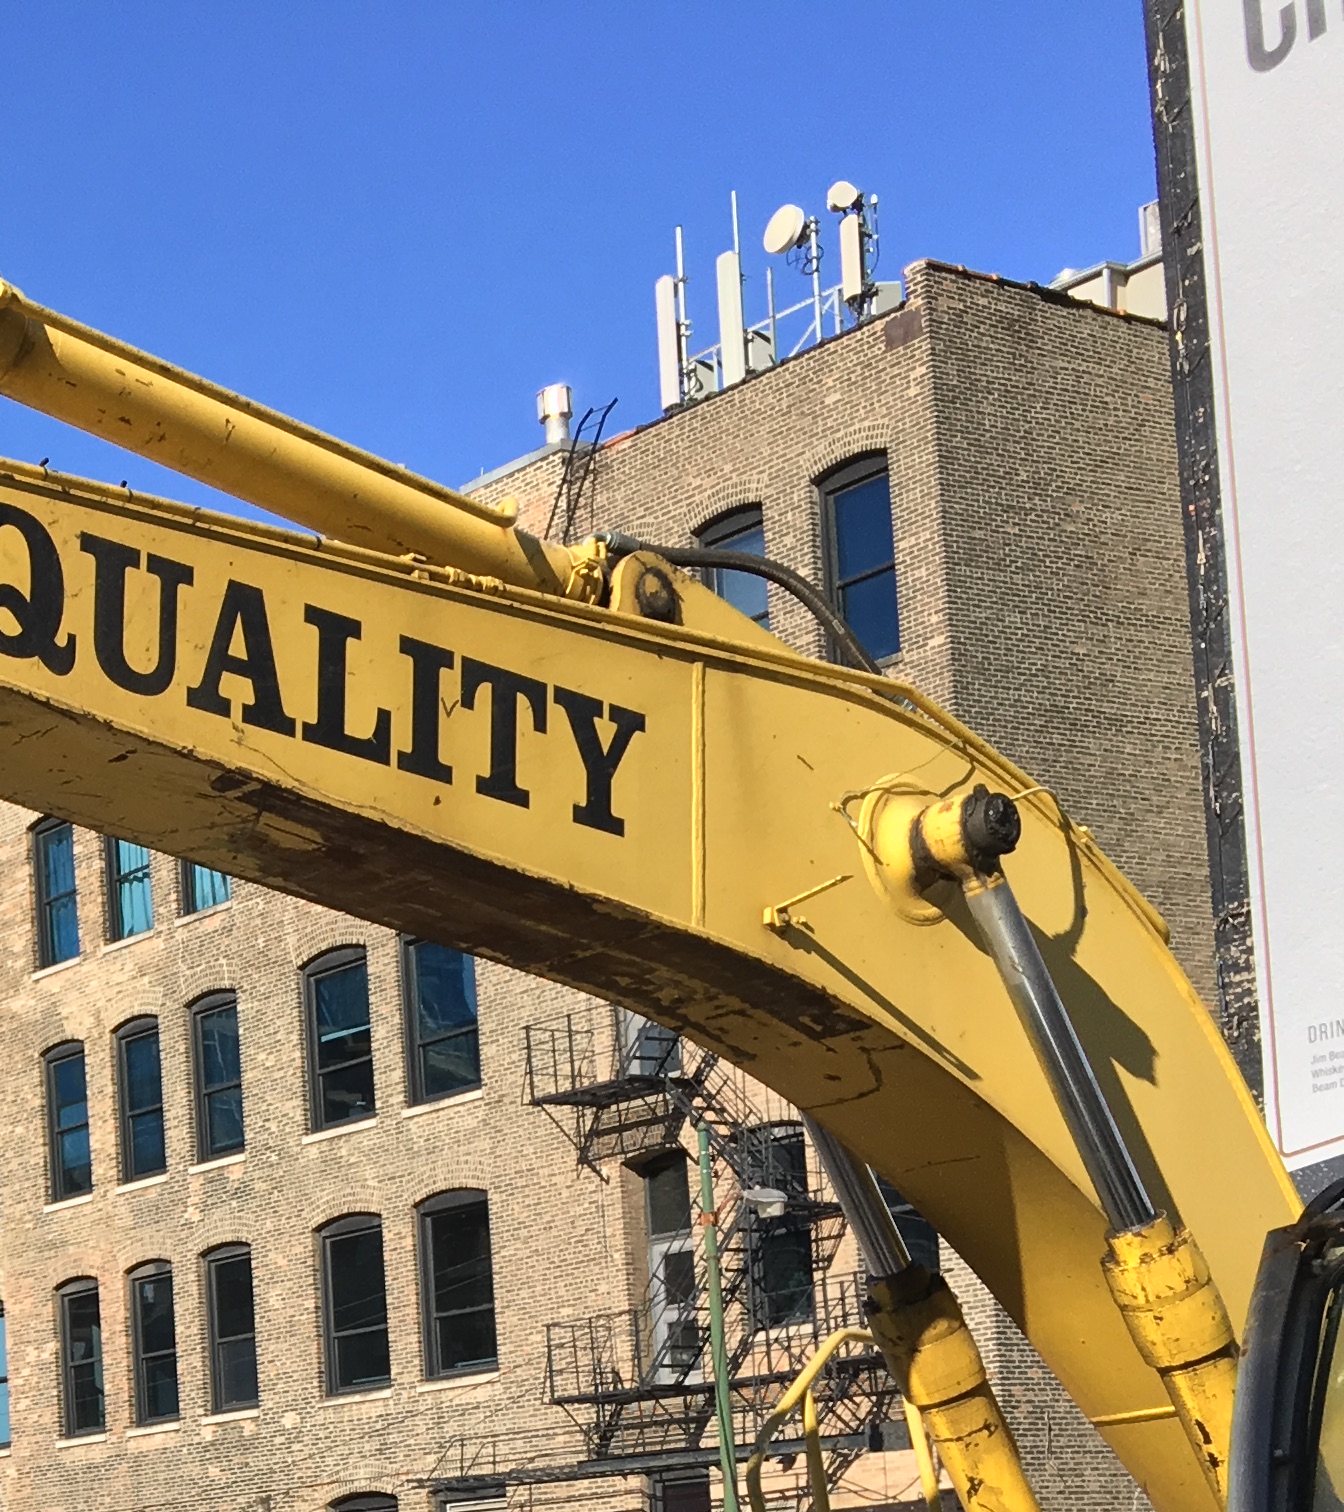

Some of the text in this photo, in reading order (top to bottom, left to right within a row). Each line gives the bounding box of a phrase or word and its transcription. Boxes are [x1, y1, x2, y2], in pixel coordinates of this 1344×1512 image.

[1308, 1019, 1344, 1043] DRIN
[1329, 1051, 1344, 1061] Bea
[1311, 1066, 1344, 1079] Whiske
